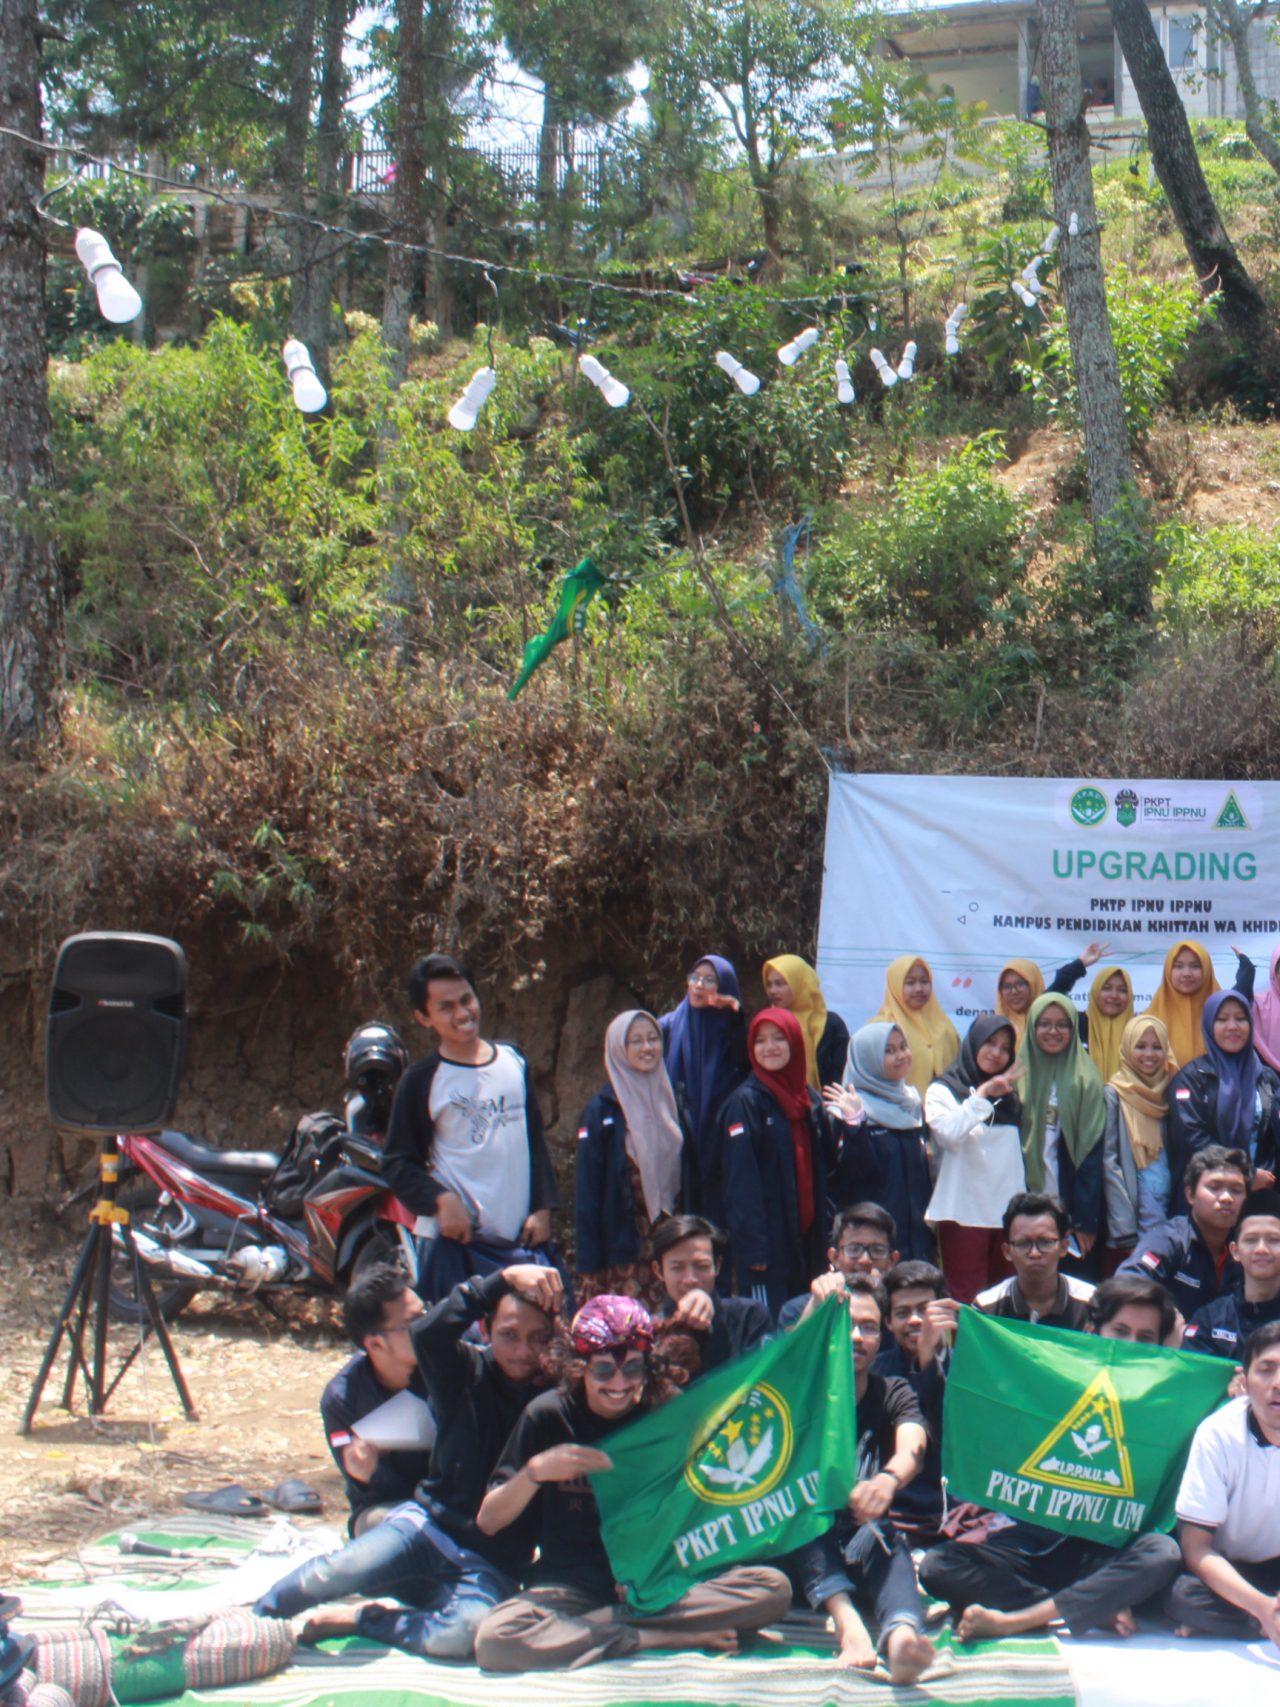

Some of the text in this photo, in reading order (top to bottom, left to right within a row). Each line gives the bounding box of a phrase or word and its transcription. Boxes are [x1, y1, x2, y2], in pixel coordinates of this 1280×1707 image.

[1144, 797, 1171, 807] PKPT
[1144, 808, 1206, 818] IPNU IPPNU
[1053, 850, 1257, 881] UPGRADING
[1090, 898, 1212, 913] PKTP IPNU IPPNU
[993, 915, 1052, 930] KAMPUS
[1057, 917, 1142, 932] PENDIDIKAN
[1148, 919, 1209, 933] KHITTAH
[1214, 920, 1236, 933] WA
[986, 1470, 1146, 1532] PKPT IPPNU UM
[673, 1470, 820, 1568] PKPT IPNU U
